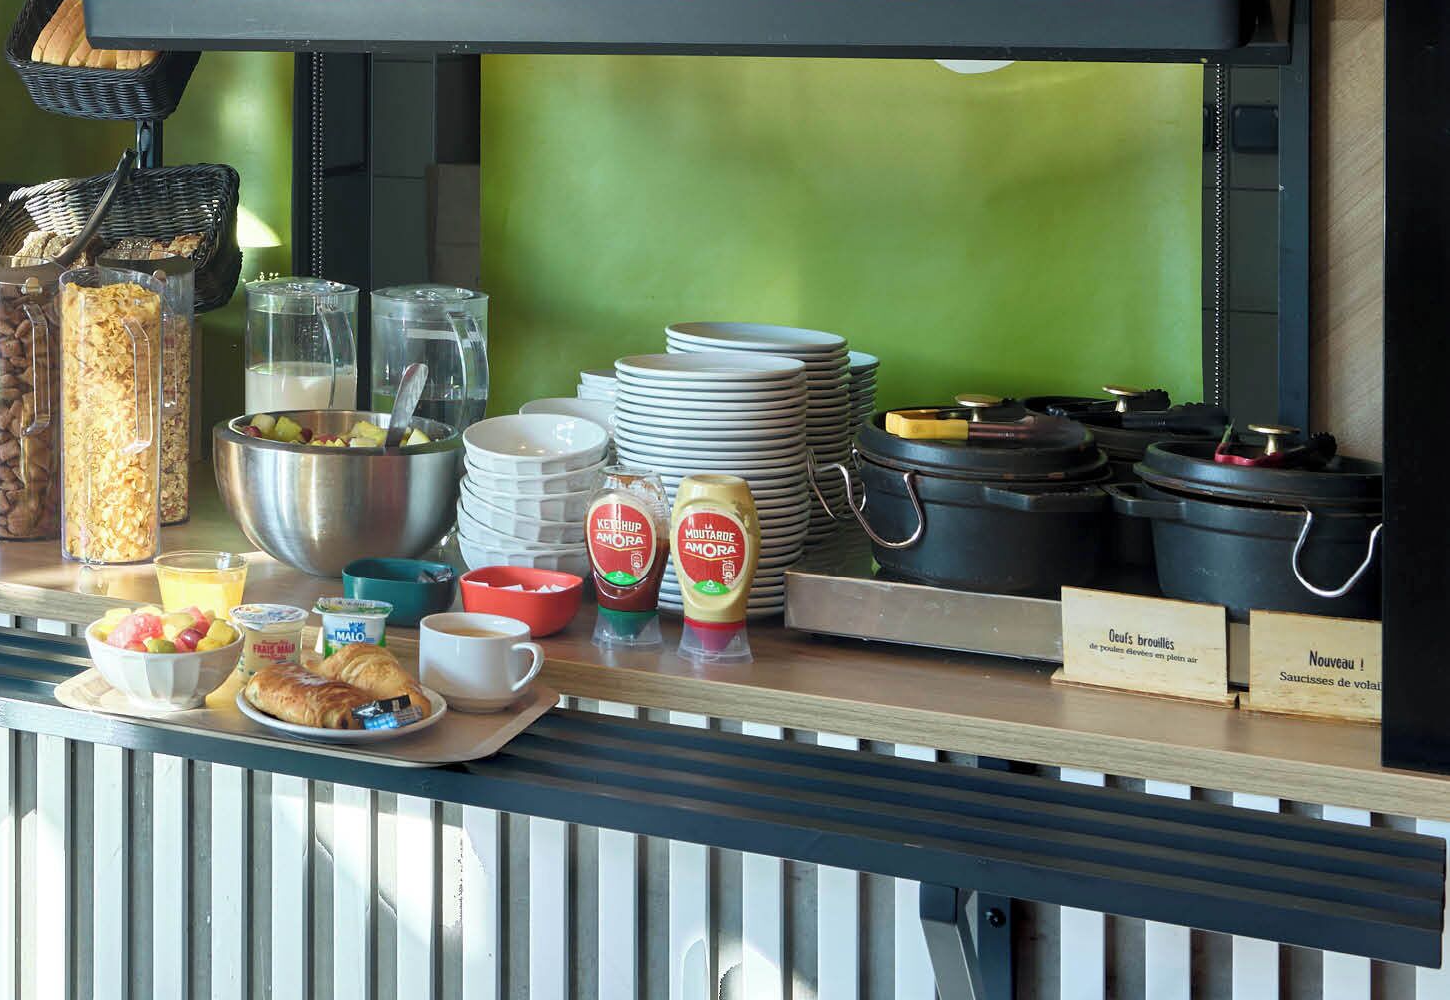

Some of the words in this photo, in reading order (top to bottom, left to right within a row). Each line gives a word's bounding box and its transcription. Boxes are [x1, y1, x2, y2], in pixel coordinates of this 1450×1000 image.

[597, 518, 642, 533] KETCHUP
[597, 532, 644, 548] AMORA
[685, 529, 736, 542] MOUTARDE
[685, 542, 737, 558] AMORA
[336, 631, 365, 642] MALO
[1109, 628, 1133, 645] Oeufs
[1100, 643, 1125, 654] poules
[1166, 653, 1186, 662] plein
[1309, 649, 1355, 670] Nouveau
[1279, 671, 1334, 686] Saucisses
[1337, 676, 1351, 687] de
